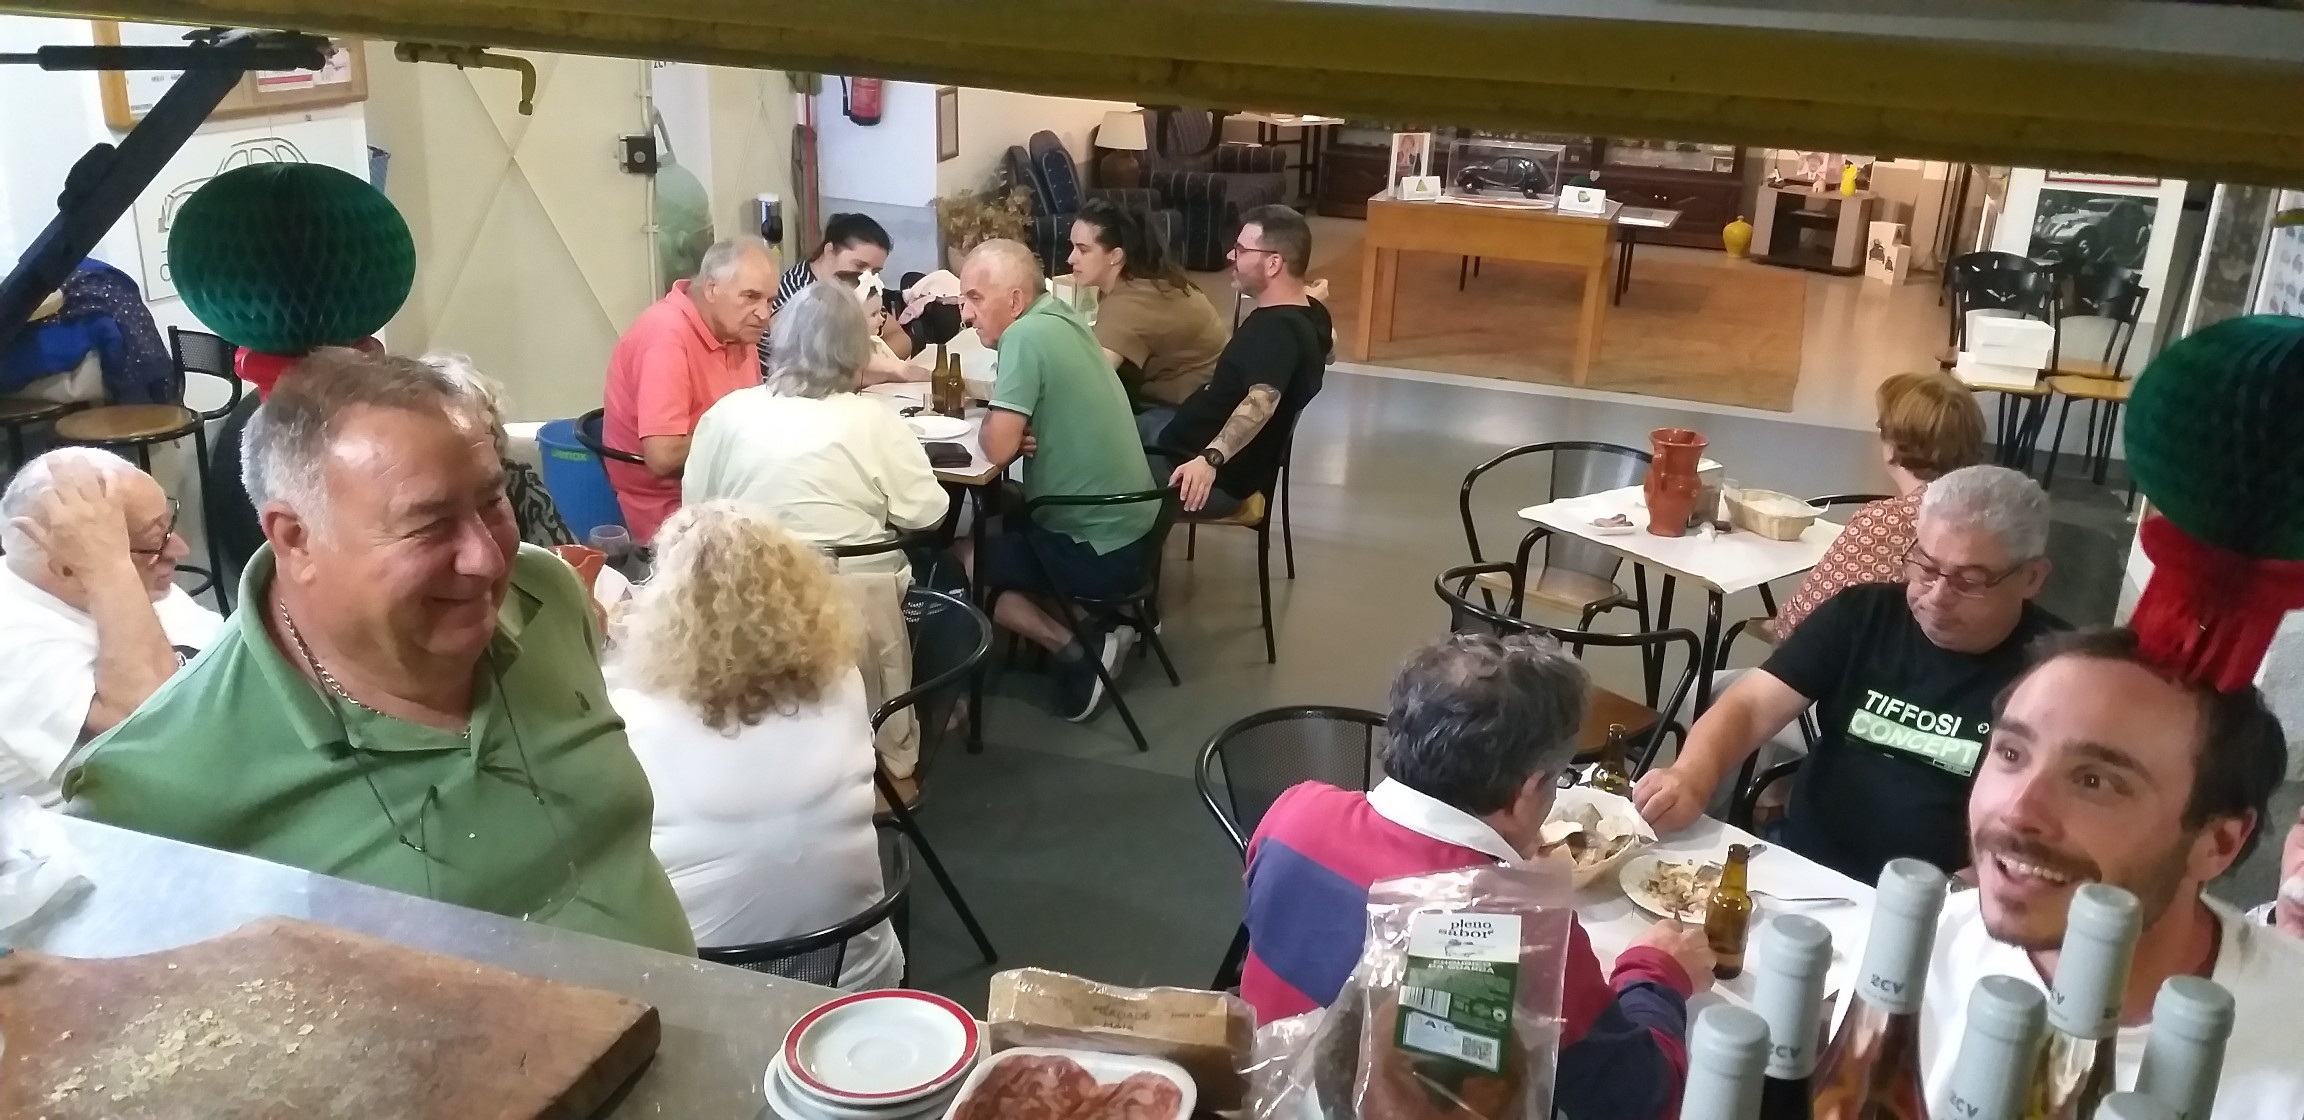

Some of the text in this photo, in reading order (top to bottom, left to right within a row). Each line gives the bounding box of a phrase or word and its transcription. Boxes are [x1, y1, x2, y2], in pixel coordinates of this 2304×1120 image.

[1865, 690, 1962, 737] TIFFOSI
[1852, 714, 1976, 763] CONCEPT
[1450, 919, 1492, 930] pleno
